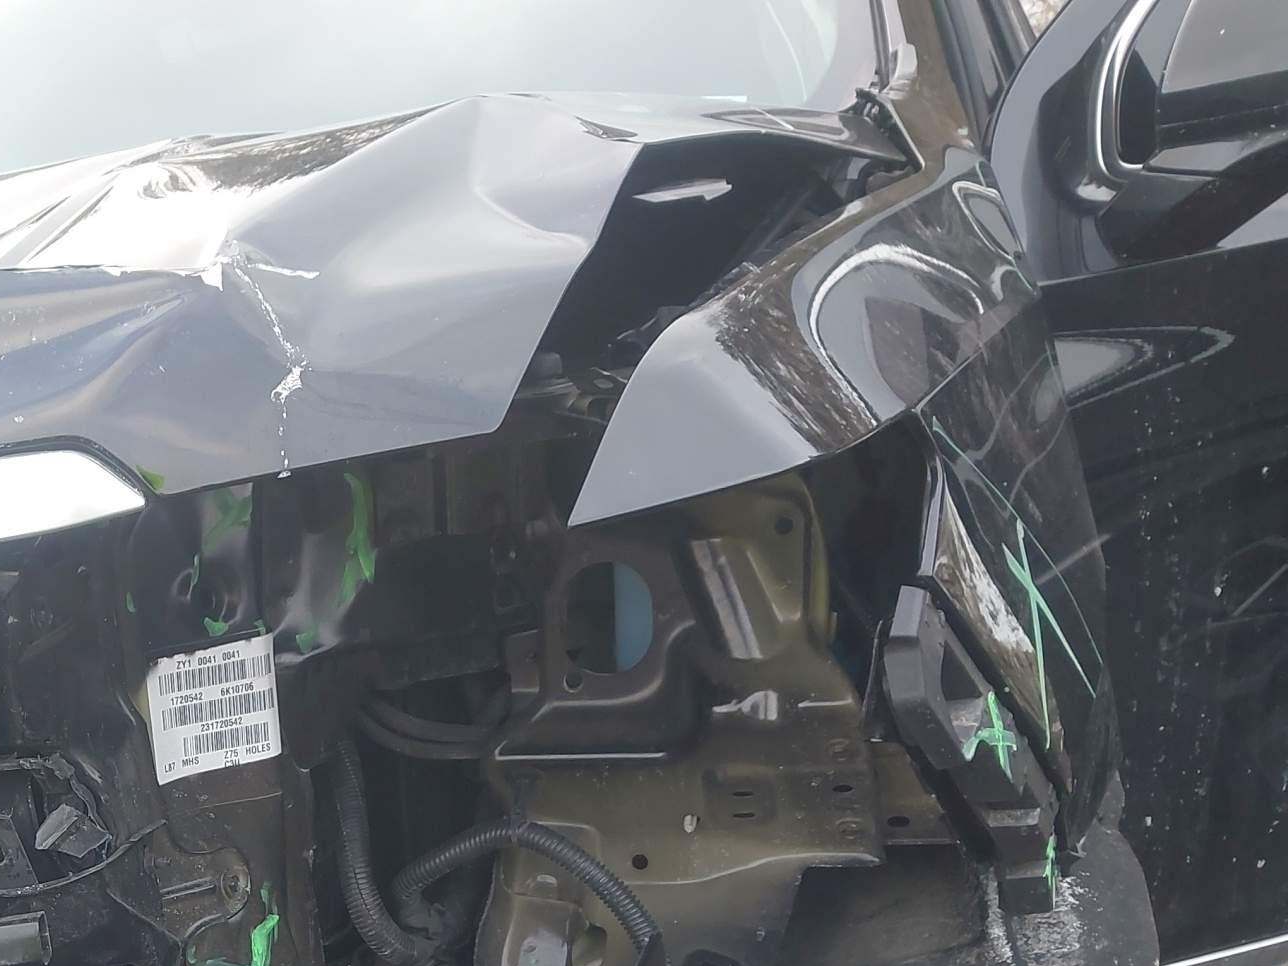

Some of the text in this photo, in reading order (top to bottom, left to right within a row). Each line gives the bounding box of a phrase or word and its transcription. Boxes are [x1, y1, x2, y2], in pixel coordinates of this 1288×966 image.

[176, 660, 191, 670] ZY1
[171, 692, 203, 706] 1720542
[200, 717, 243, 732] 231720542
[182, 757, 199, 767] MHS
[224, 749, 238, 759] Z75
[245, 743, 271, 755] HOLES
